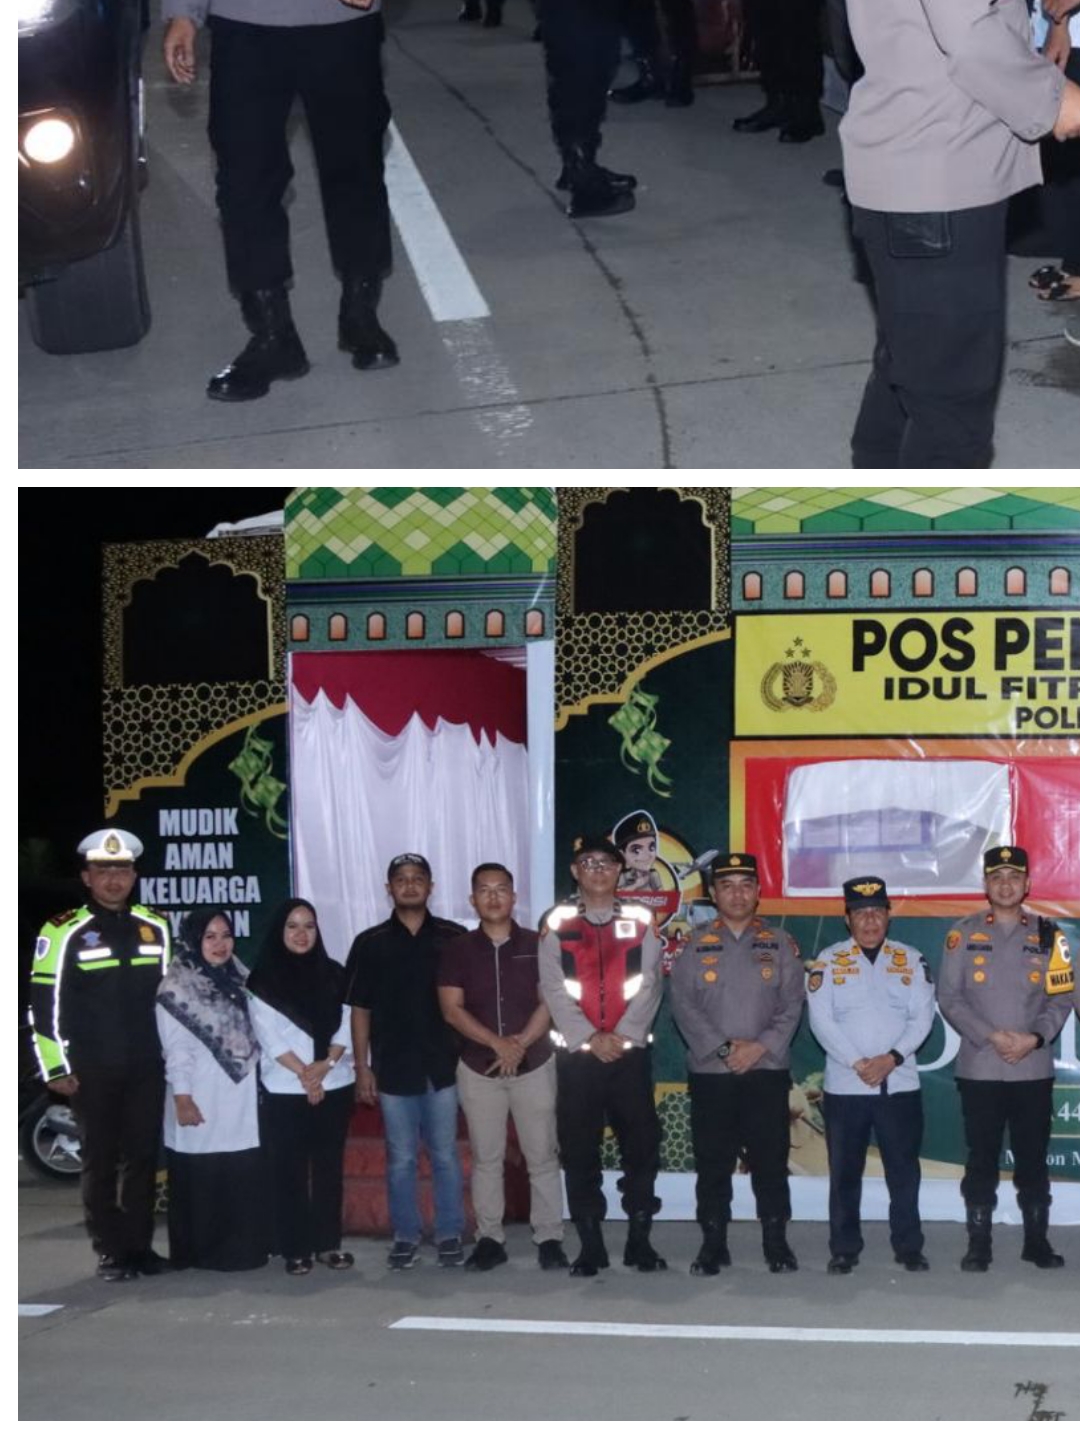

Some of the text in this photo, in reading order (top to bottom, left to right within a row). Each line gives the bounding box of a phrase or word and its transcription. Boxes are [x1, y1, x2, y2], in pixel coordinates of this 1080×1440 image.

[852, 616, 976, 673] POS
[884, 676, 988, 701] IDUL
[158, 807, 240, 837] MUDIK
[164, 842, 235, 870] AMAN
[139, 875, 262, 905] KELUARGA
